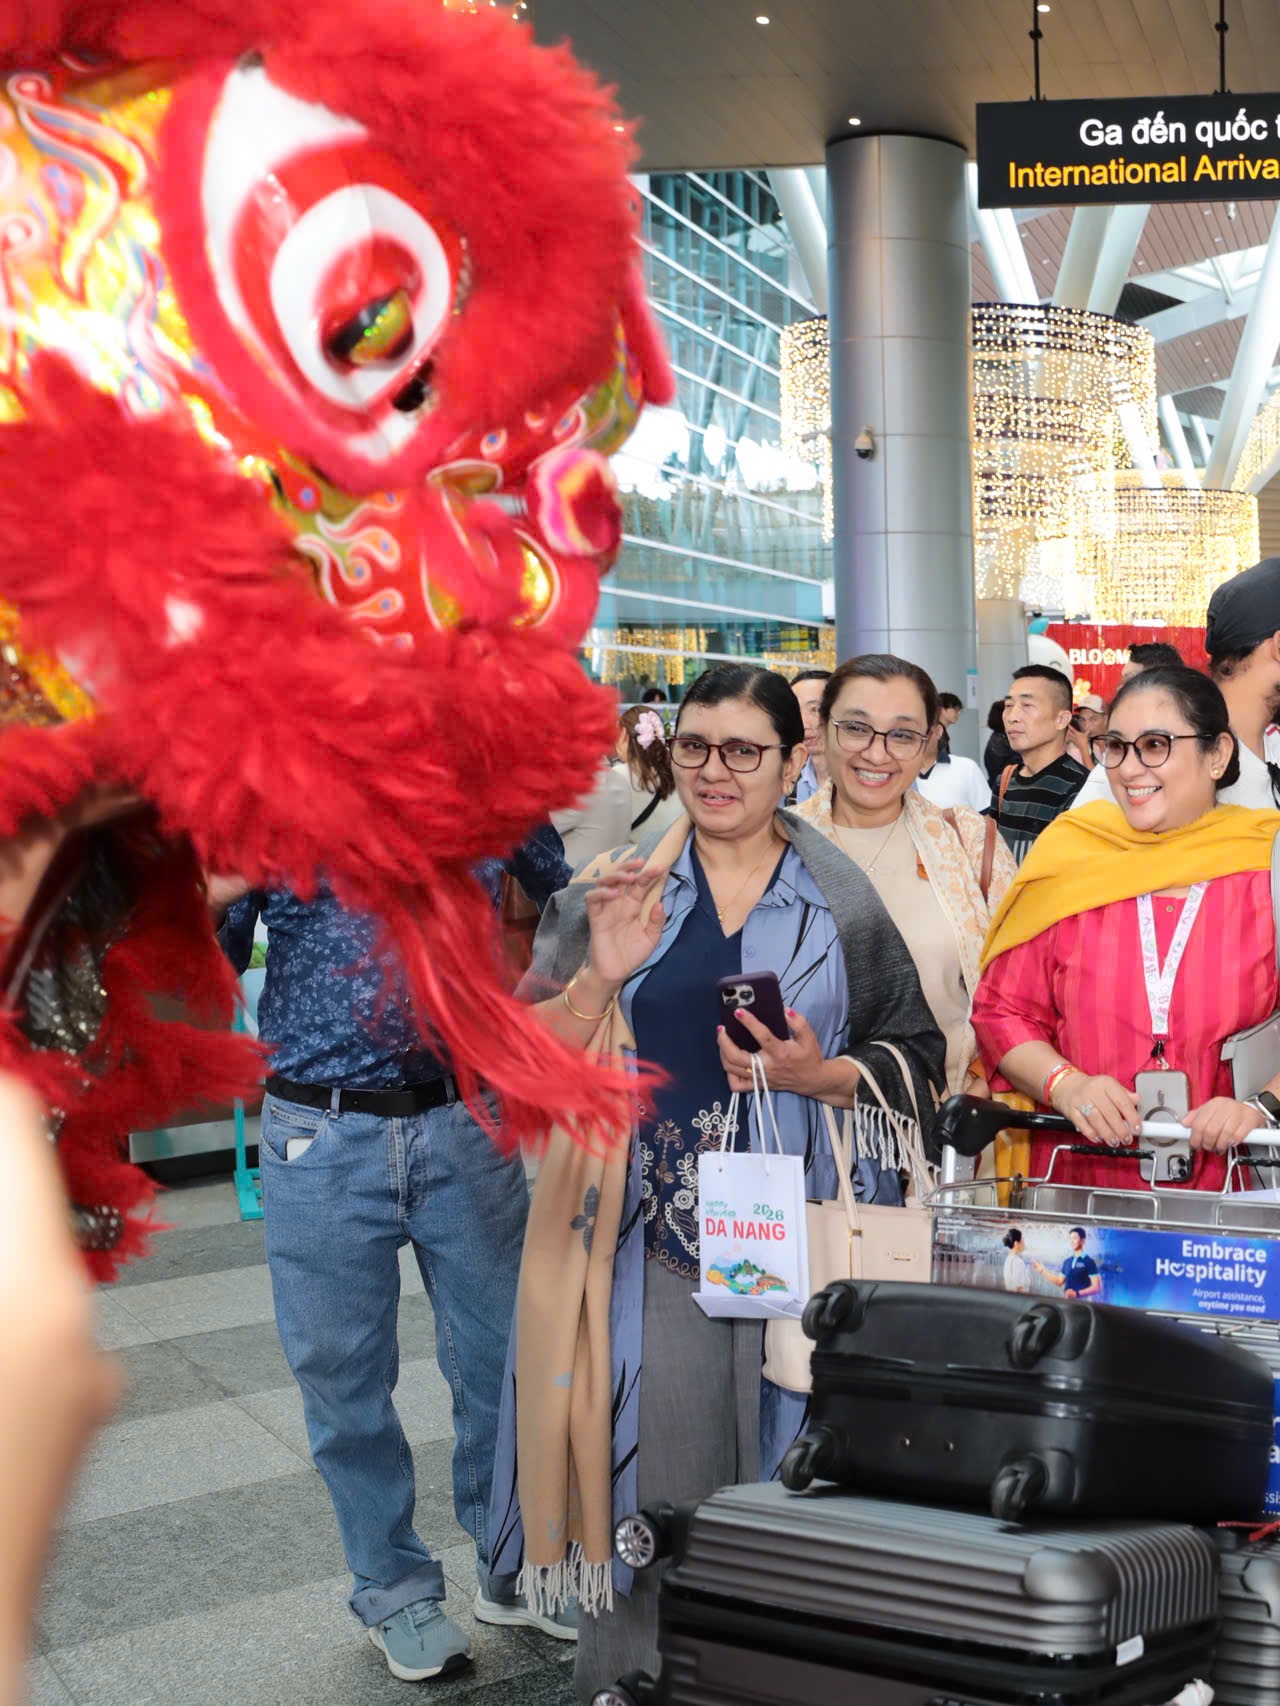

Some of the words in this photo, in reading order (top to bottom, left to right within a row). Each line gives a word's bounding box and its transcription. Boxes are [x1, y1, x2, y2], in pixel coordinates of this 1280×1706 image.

[1079, 118, 1123, 146] Ga
[1132, 110, 1186, 144] đến
[1195, 108, 1268, 148] quốc
[1008, 154, 1186, 188] International
[753, 1203, 785, 1221] 2026
[705, 1217, 727, 1238] DA
[733, 1219, 786, 1241] NANG
[1182, 1240, 1267, 1263] Embrace
[1156, 1257, 1267, 1289] Hospitality
[1192, 1288, 1221, 1300] Airport
[1222, 1290, 1265, 1304] assistance,
[1229, 1303, 1246, 1313] you
